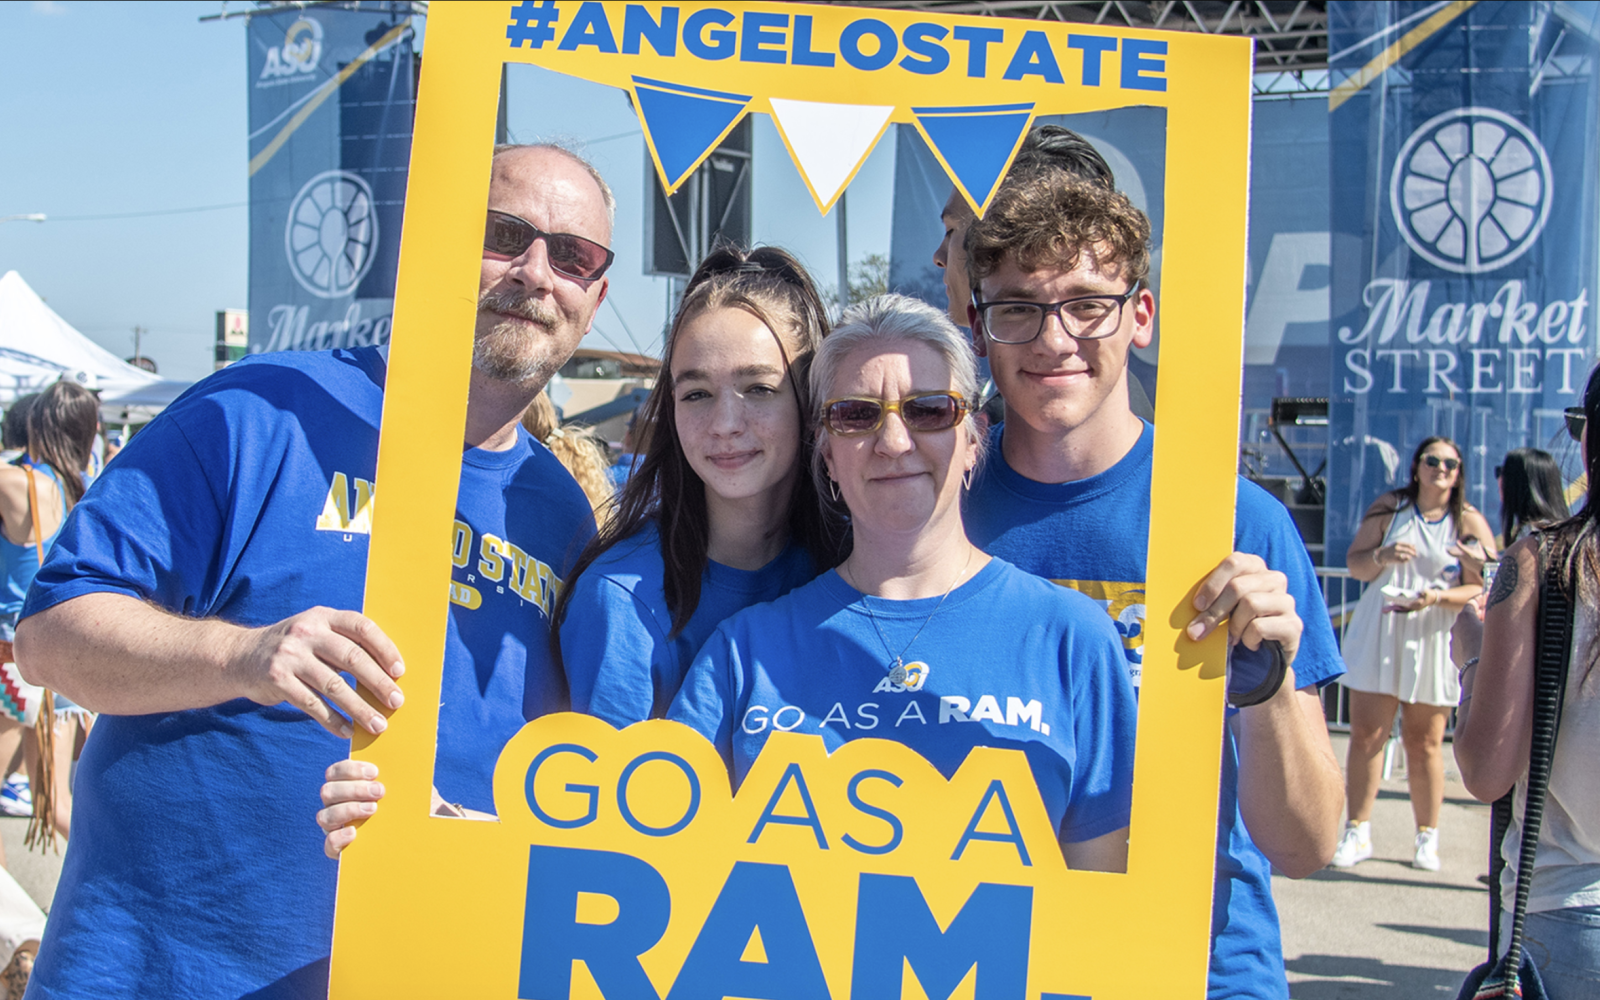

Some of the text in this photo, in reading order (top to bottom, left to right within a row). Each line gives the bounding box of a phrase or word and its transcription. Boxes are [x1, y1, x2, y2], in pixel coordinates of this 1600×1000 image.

[506, 0, 1168, 92] #ANGELOSTATE
[251, 302, 392, 354] Marke
[1338, 278, 1588, 345] Market
[1344, 348, 1585, 394] STREET
[741, 694, 1051, 736] GO AS A RAM.
[524, 743, 1033, 867] GO AS A
[517, 844, 1093, 1000] RAM
